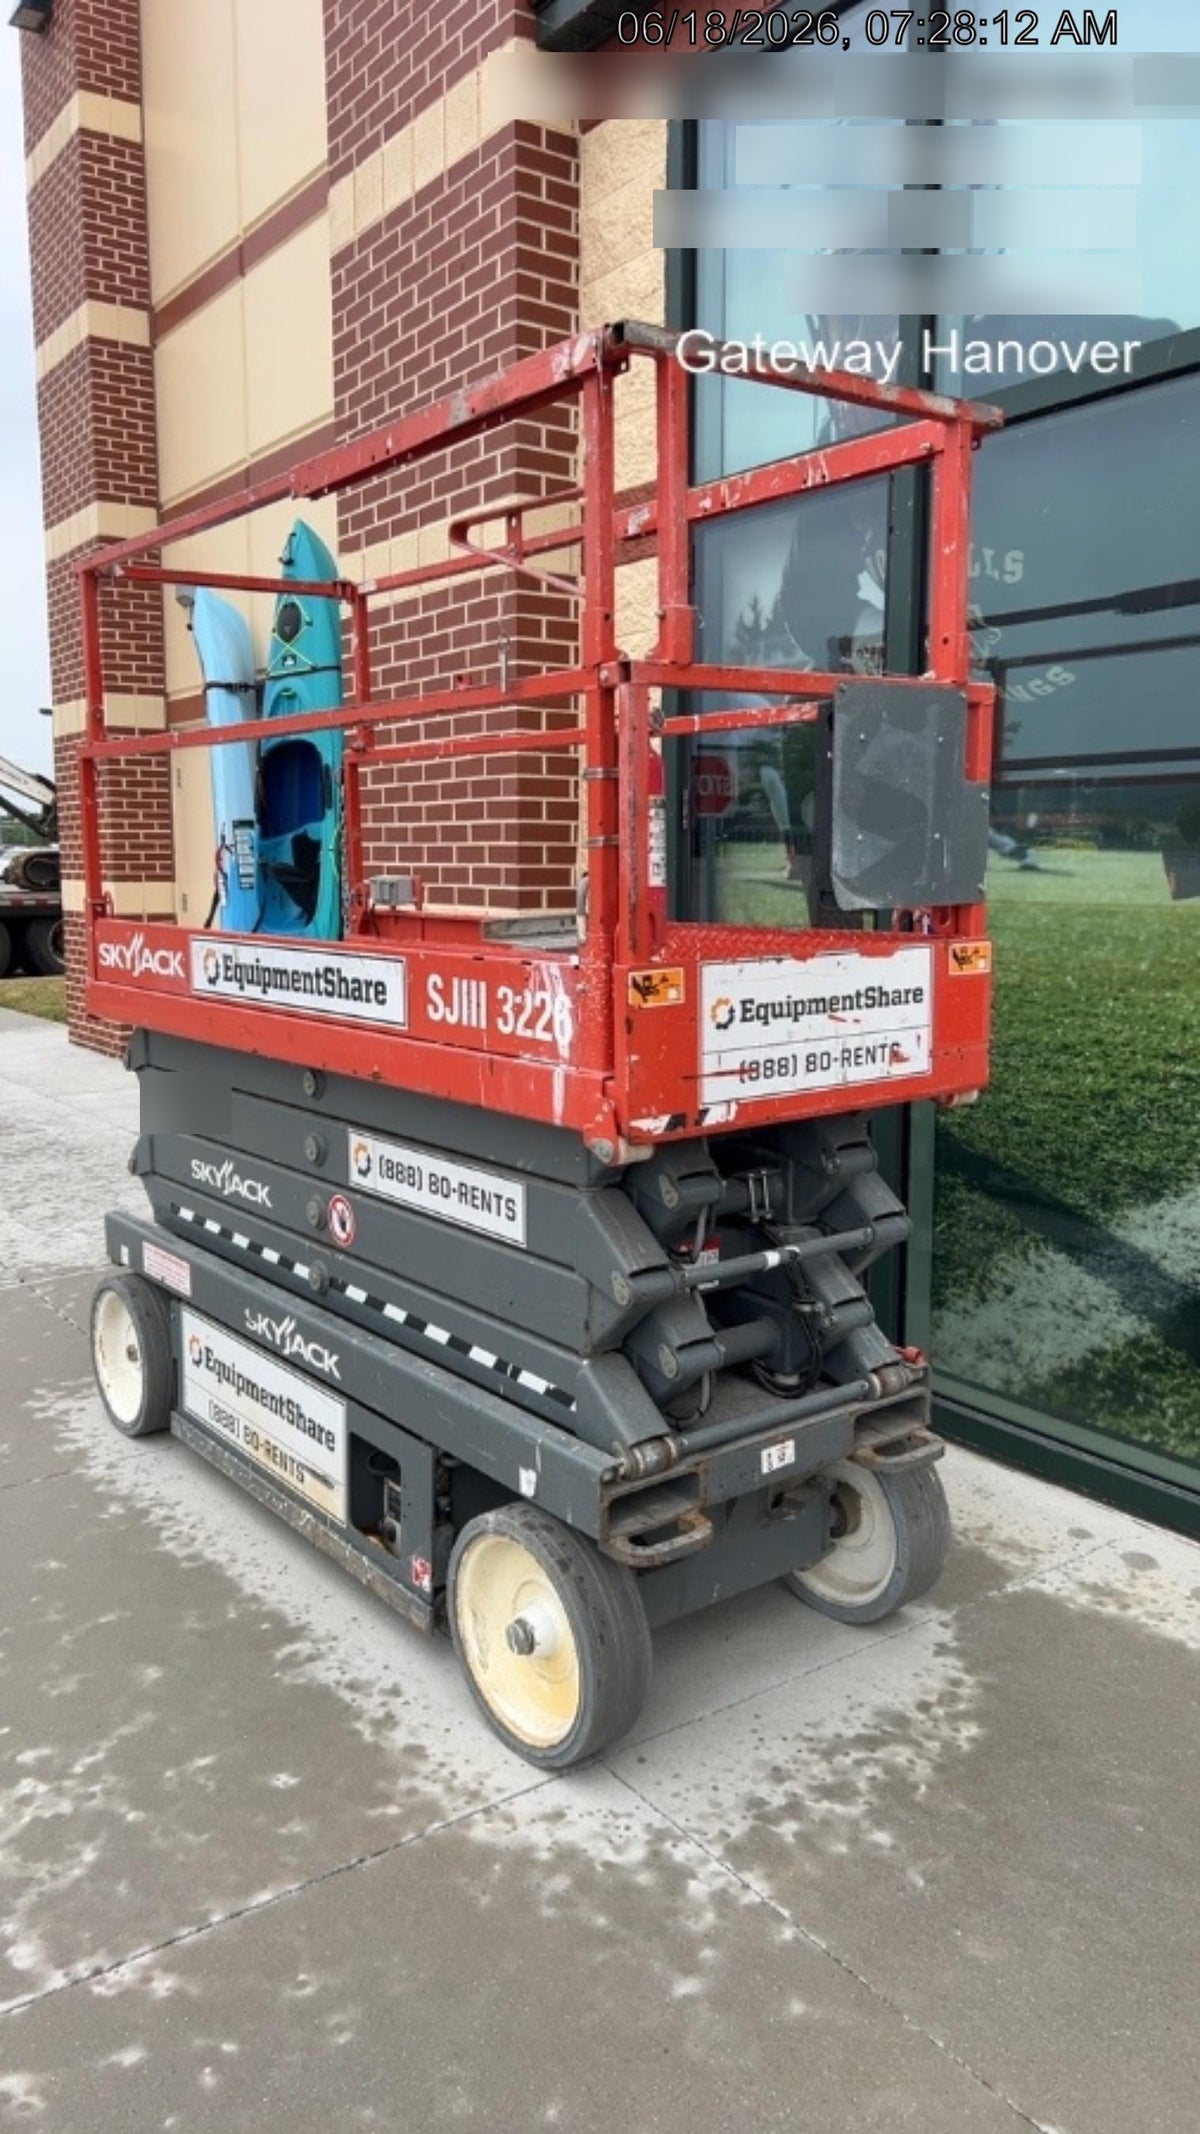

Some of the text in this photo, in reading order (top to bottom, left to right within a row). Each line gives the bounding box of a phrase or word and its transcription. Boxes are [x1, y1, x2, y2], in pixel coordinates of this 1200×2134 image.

[967, 543, 1025, 584] LLS
[1003, 664, 1077, 702] NGS
[99, 932, 185, 979] SKYJACK
[222, 954, 388, 1007] EquipmentShare
[739, 985, 925, 1027] EquipmentShare
[191, 1158, 273, 1208] SKYJACK
[379, 1154, 517, 1222] (888) 80-RENTS
[244, 1307, 342, 1381] SKYJACK
[204, 1346, 336, 1453] EquipmentShare
